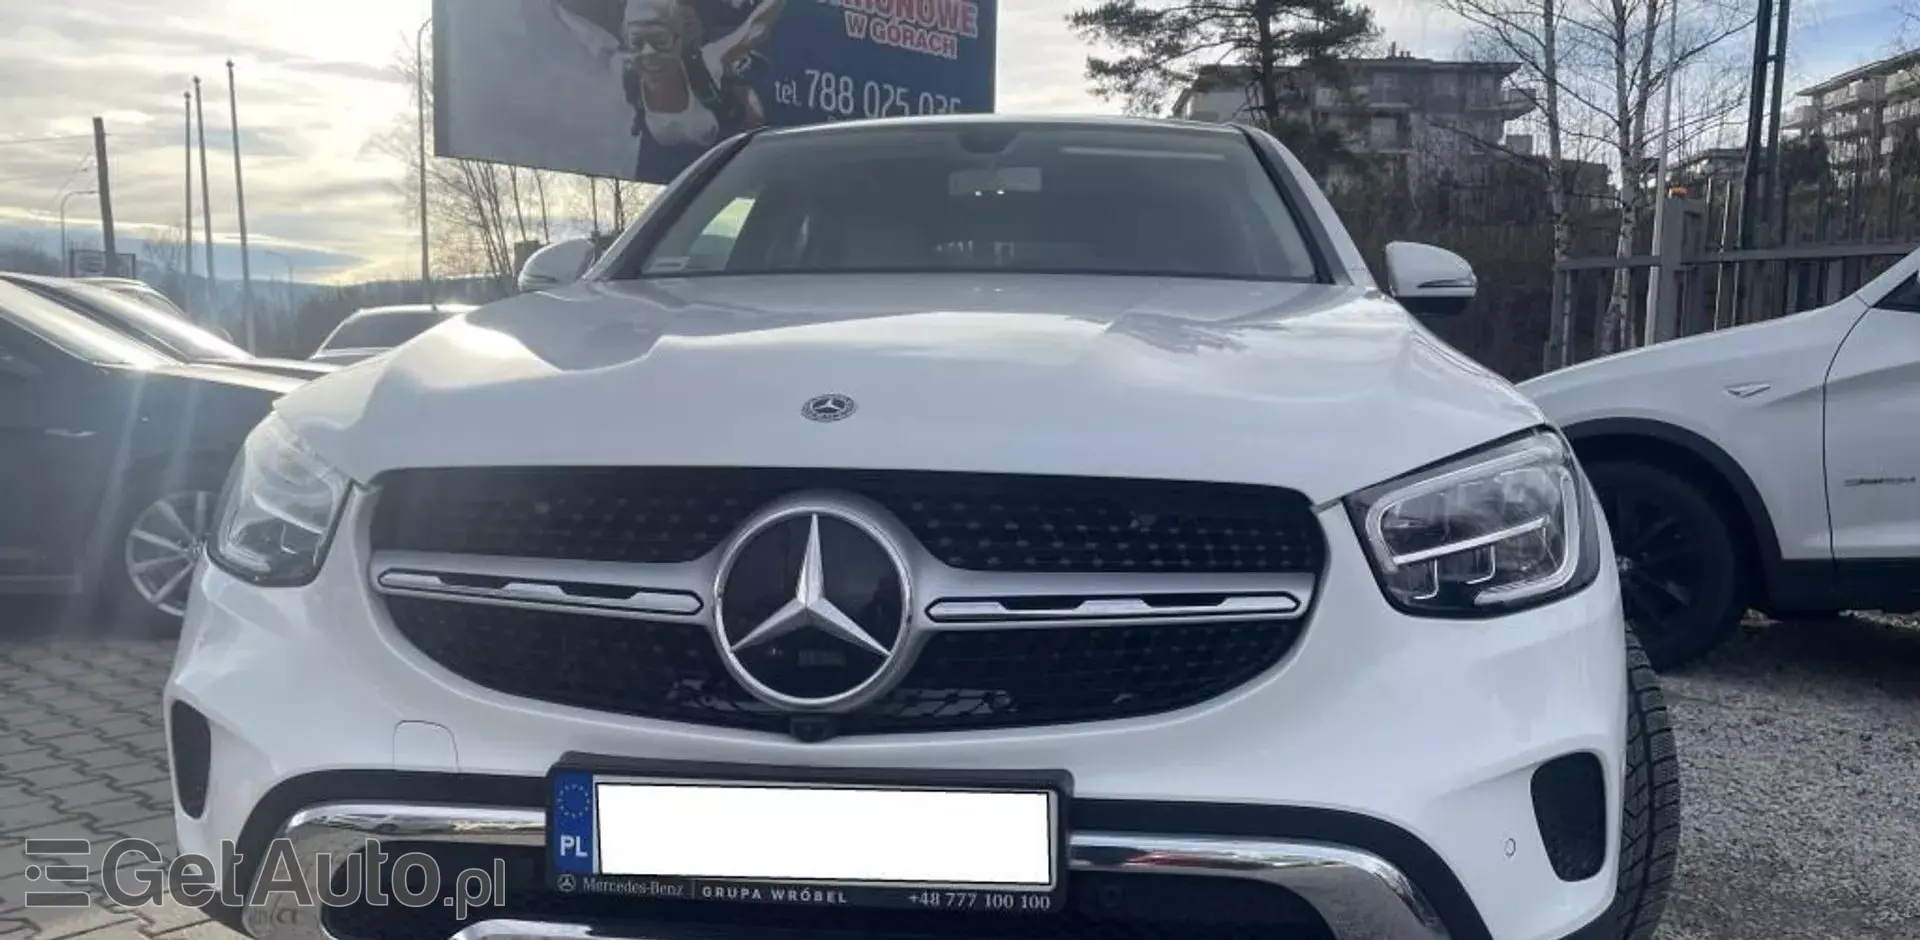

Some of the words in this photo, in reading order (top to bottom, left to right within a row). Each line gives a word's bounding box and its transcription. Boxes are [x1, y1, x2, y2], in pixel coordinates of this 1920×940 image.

[844, 11, 868, 39] W
[870, 17, 958, 60] GÓRACH
[805, 69, 854, 115] 788
[560, 834, 588, 857] PL
[583, 877, 685, 897] Mercedes-Benz
[702, 886, 762, 900] GRUPA
[770, 887, 848, 904] WRÓBEL
[908, 891, 941, 907] +48
[945, 892, 977, 908] 777
[985, 893, 1014, 909] 100
[1021, 894, 1051, 910] 100
